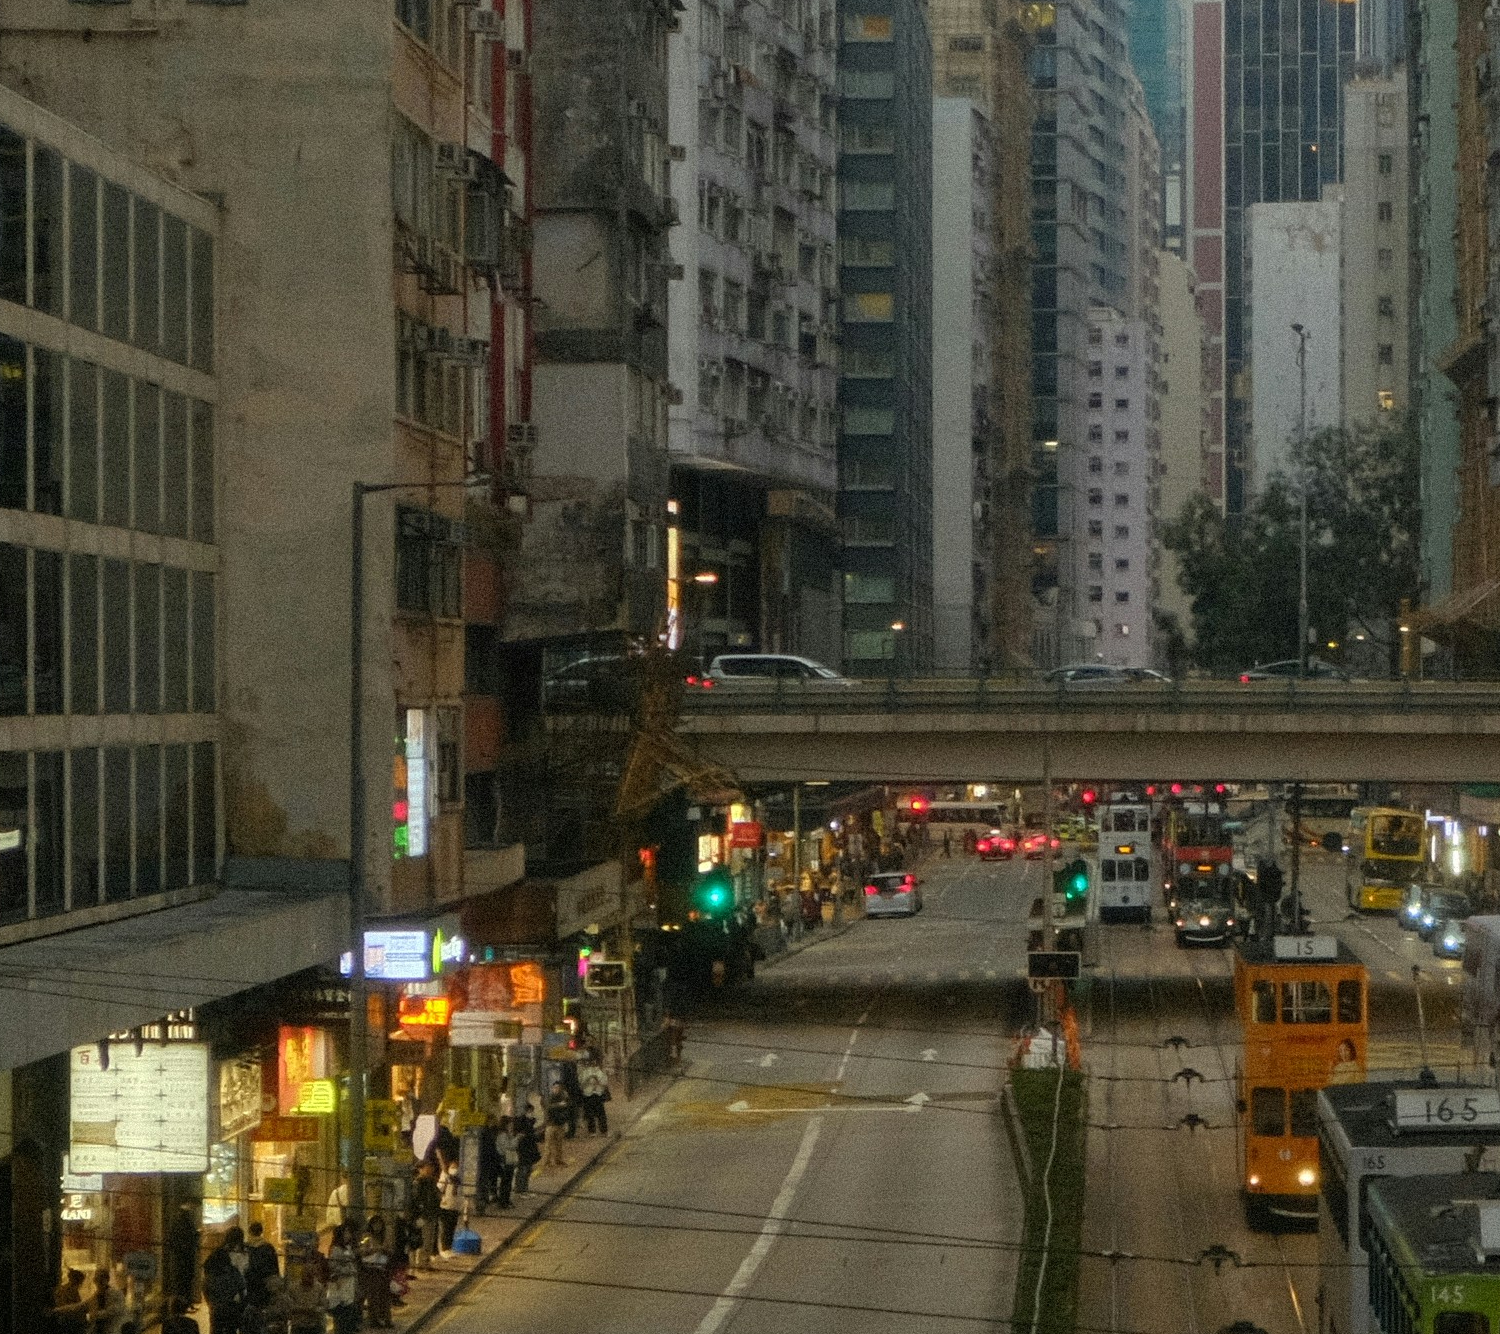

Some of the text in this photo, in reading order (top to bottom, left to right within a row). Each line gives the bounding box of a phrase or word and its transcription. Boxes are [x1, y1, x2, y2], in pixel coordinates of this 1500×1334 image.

[1425, 1097, 1479, 1123] 165
[1362, 1154, 1386, 1169] 165
[1430, 1285, 1465, 1305] 145
